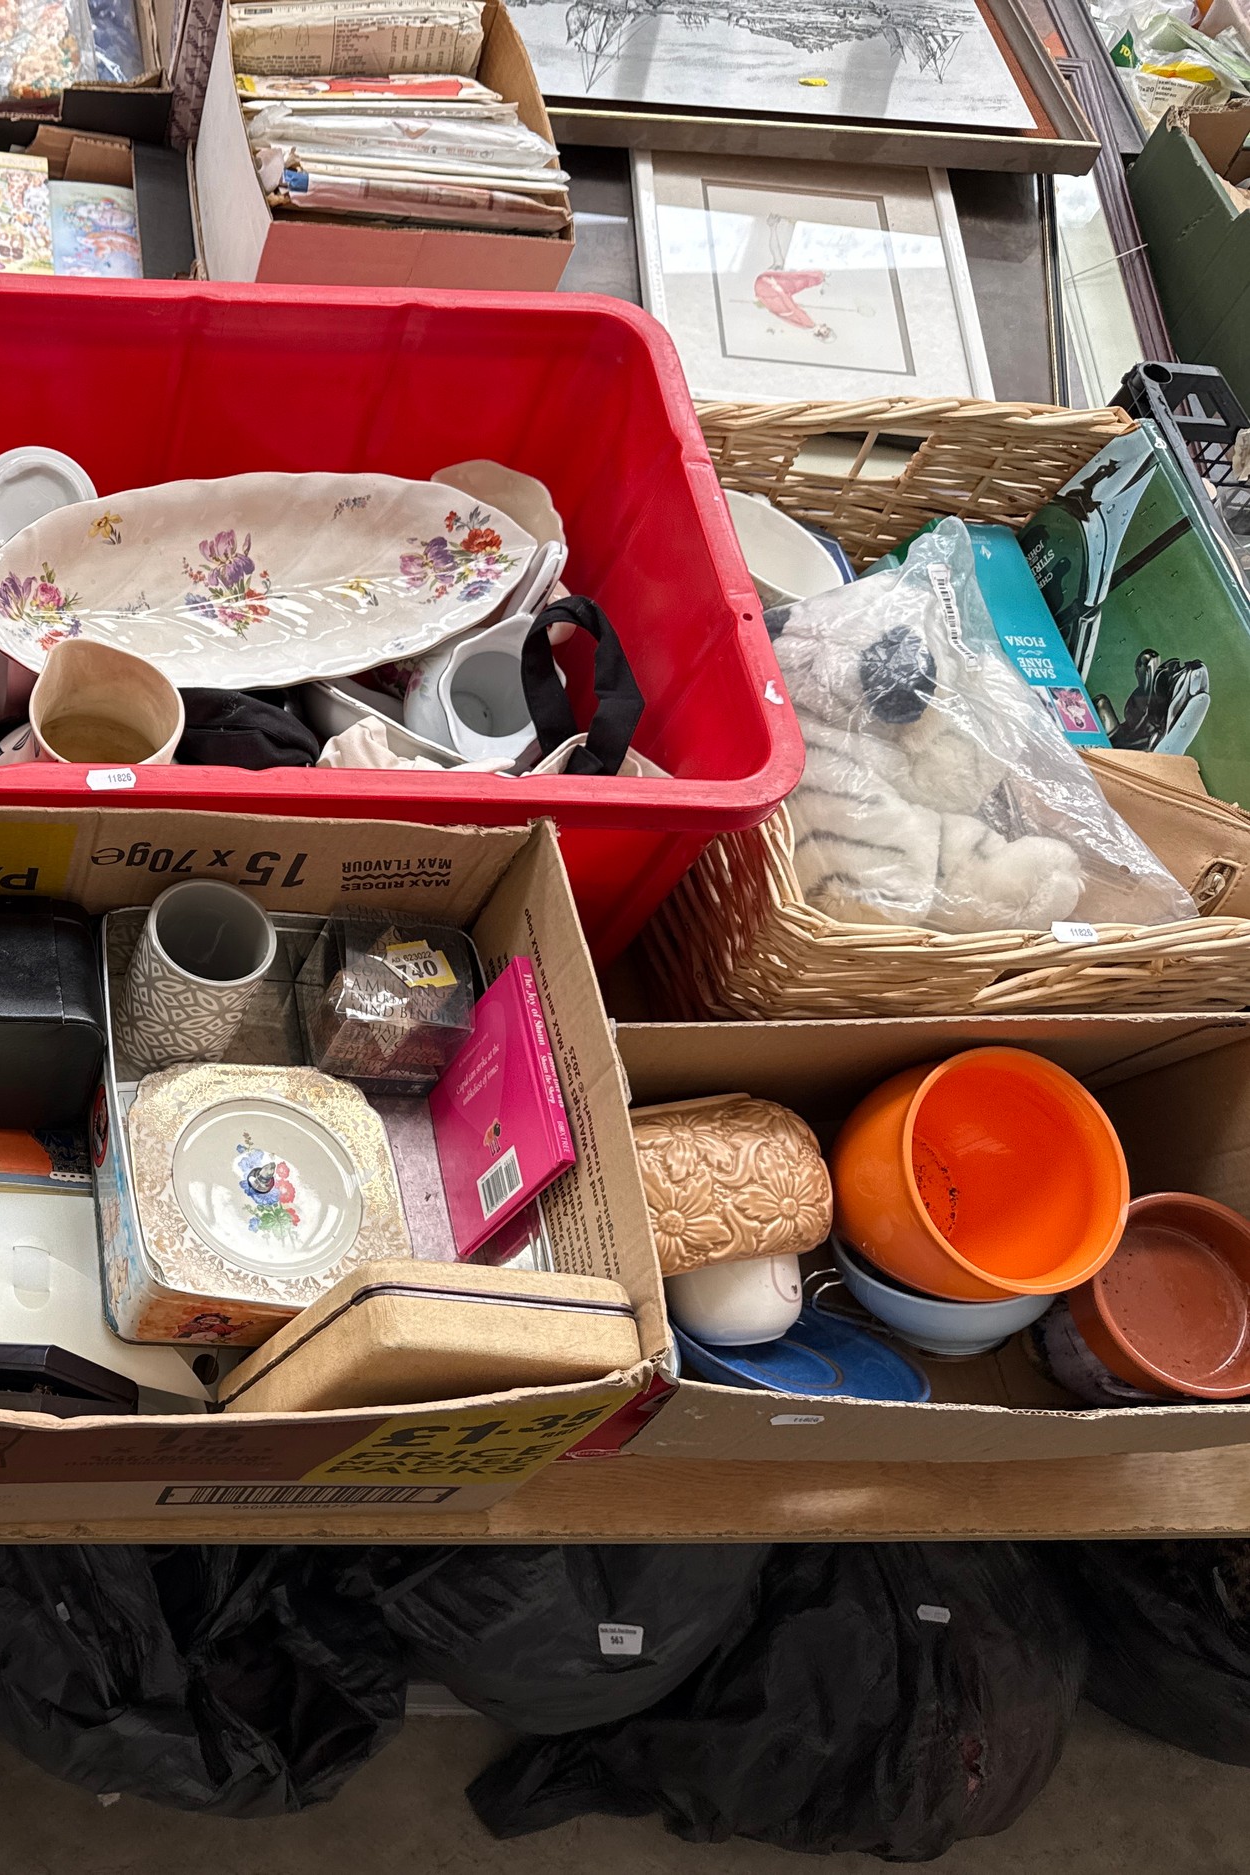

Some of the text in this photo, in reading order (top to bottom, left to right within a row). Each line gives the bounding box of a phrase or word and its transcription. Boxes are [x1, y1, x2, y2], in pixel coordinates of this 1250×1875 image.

[1004, 635, 1047, 648] FIONA
[1017, 657, 1054, 669] DANE
[1022, 667, 1057, 680] SARA
[106, 771, 133, 784] 11826
[207, 850, 236, 868] x
[342, 857, 452, 874] MAX FLAVOUR
[239, 851, 309, 888] 15
[340, 878, 451, 892] MAX RIDGES
[1068, 927, 1094, 939] 11826
[403, 951, 432, 962] 623022
[351, 1003, 394, 1018] MIND
[522, 972, 546, 1047] The Joy of Shaun
[567, 1045, 581, 1079] 2025
[486, 1063, 500, 1080] times
[540, 1054, 549, 1073] Shaun
[547, 1085, 556, 1105] Sheep
[455, 1078, 470, 1096] Cupid
[524, 907, 614, 1281] WALKERS, and the WALKERS logo, MAX and the MAX logo
[566, 1183, 581, 1243] available
[597, 1173, 617, 1250] registered
[577, 1194, 594, 1271] Contact Us
[612, 1249, 621, 1276] are
[350, 1440, 565, 1460] PRICE
[339, 1454, 543, 1466] MARKED
[325, 1464, 527, 1475] PACKS
